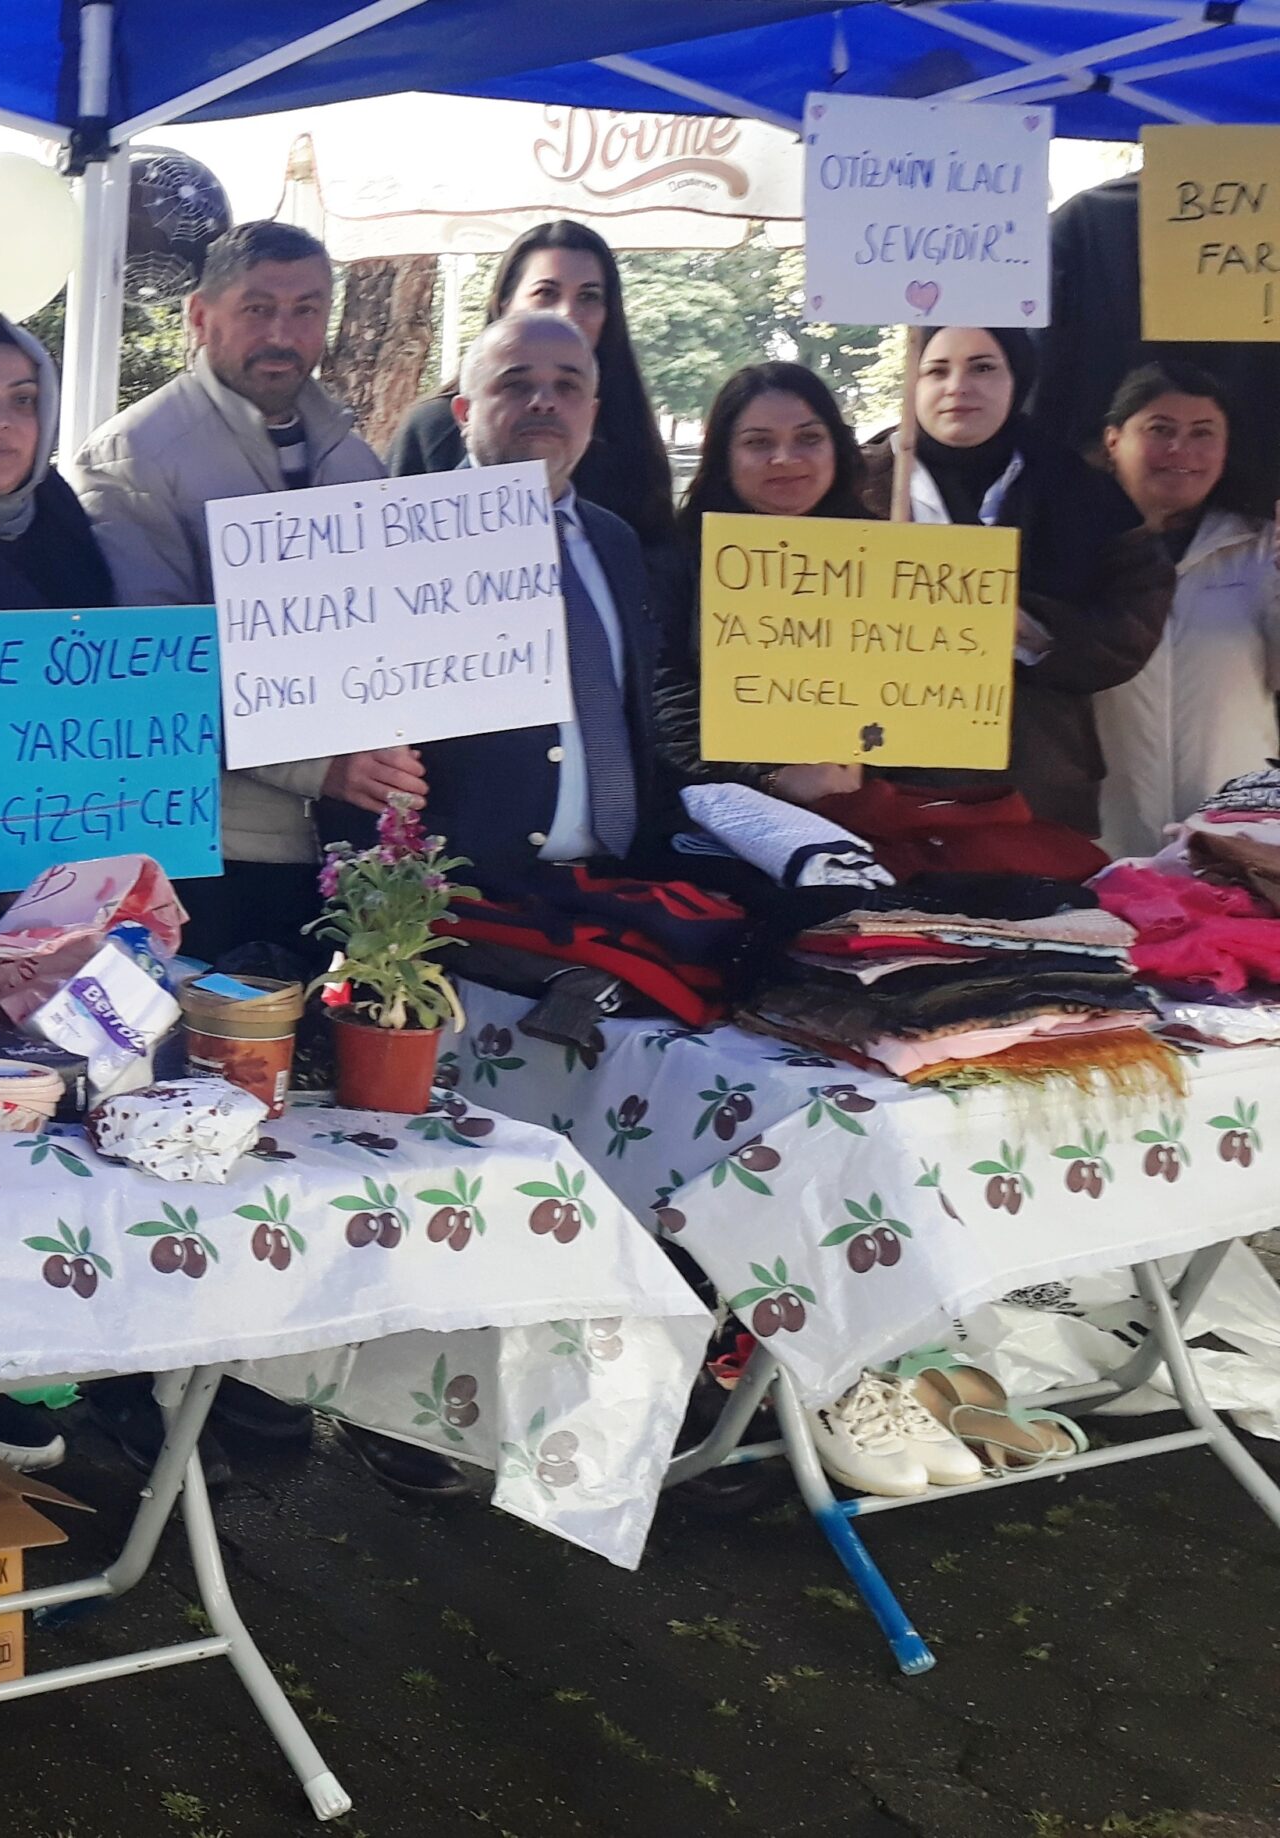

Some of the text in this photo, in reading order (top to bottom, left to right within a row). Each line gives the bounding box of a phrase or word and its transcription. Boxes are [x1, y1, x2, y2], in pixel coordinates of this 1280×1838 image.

[1168, 181, 1268, 222] BEN
[1198, 242, 1280, 275] FAR
[220, 479, 551, 568] OTİZMLİ BİREYLERİN
[715, 541, 1017, 605] OTİZMİ FARKET
[225, 562, 561, 643] HAKLARI VAR ONLARA
[712, 612, 832, 649] YAŞAMI
[43, 628, 214, 686] SÖYLEME
[233, 671, 317, 717] SAYGI
[734, 674, 860, 708] ENGEL
[8, 712, 222, 762] YARGILARA
